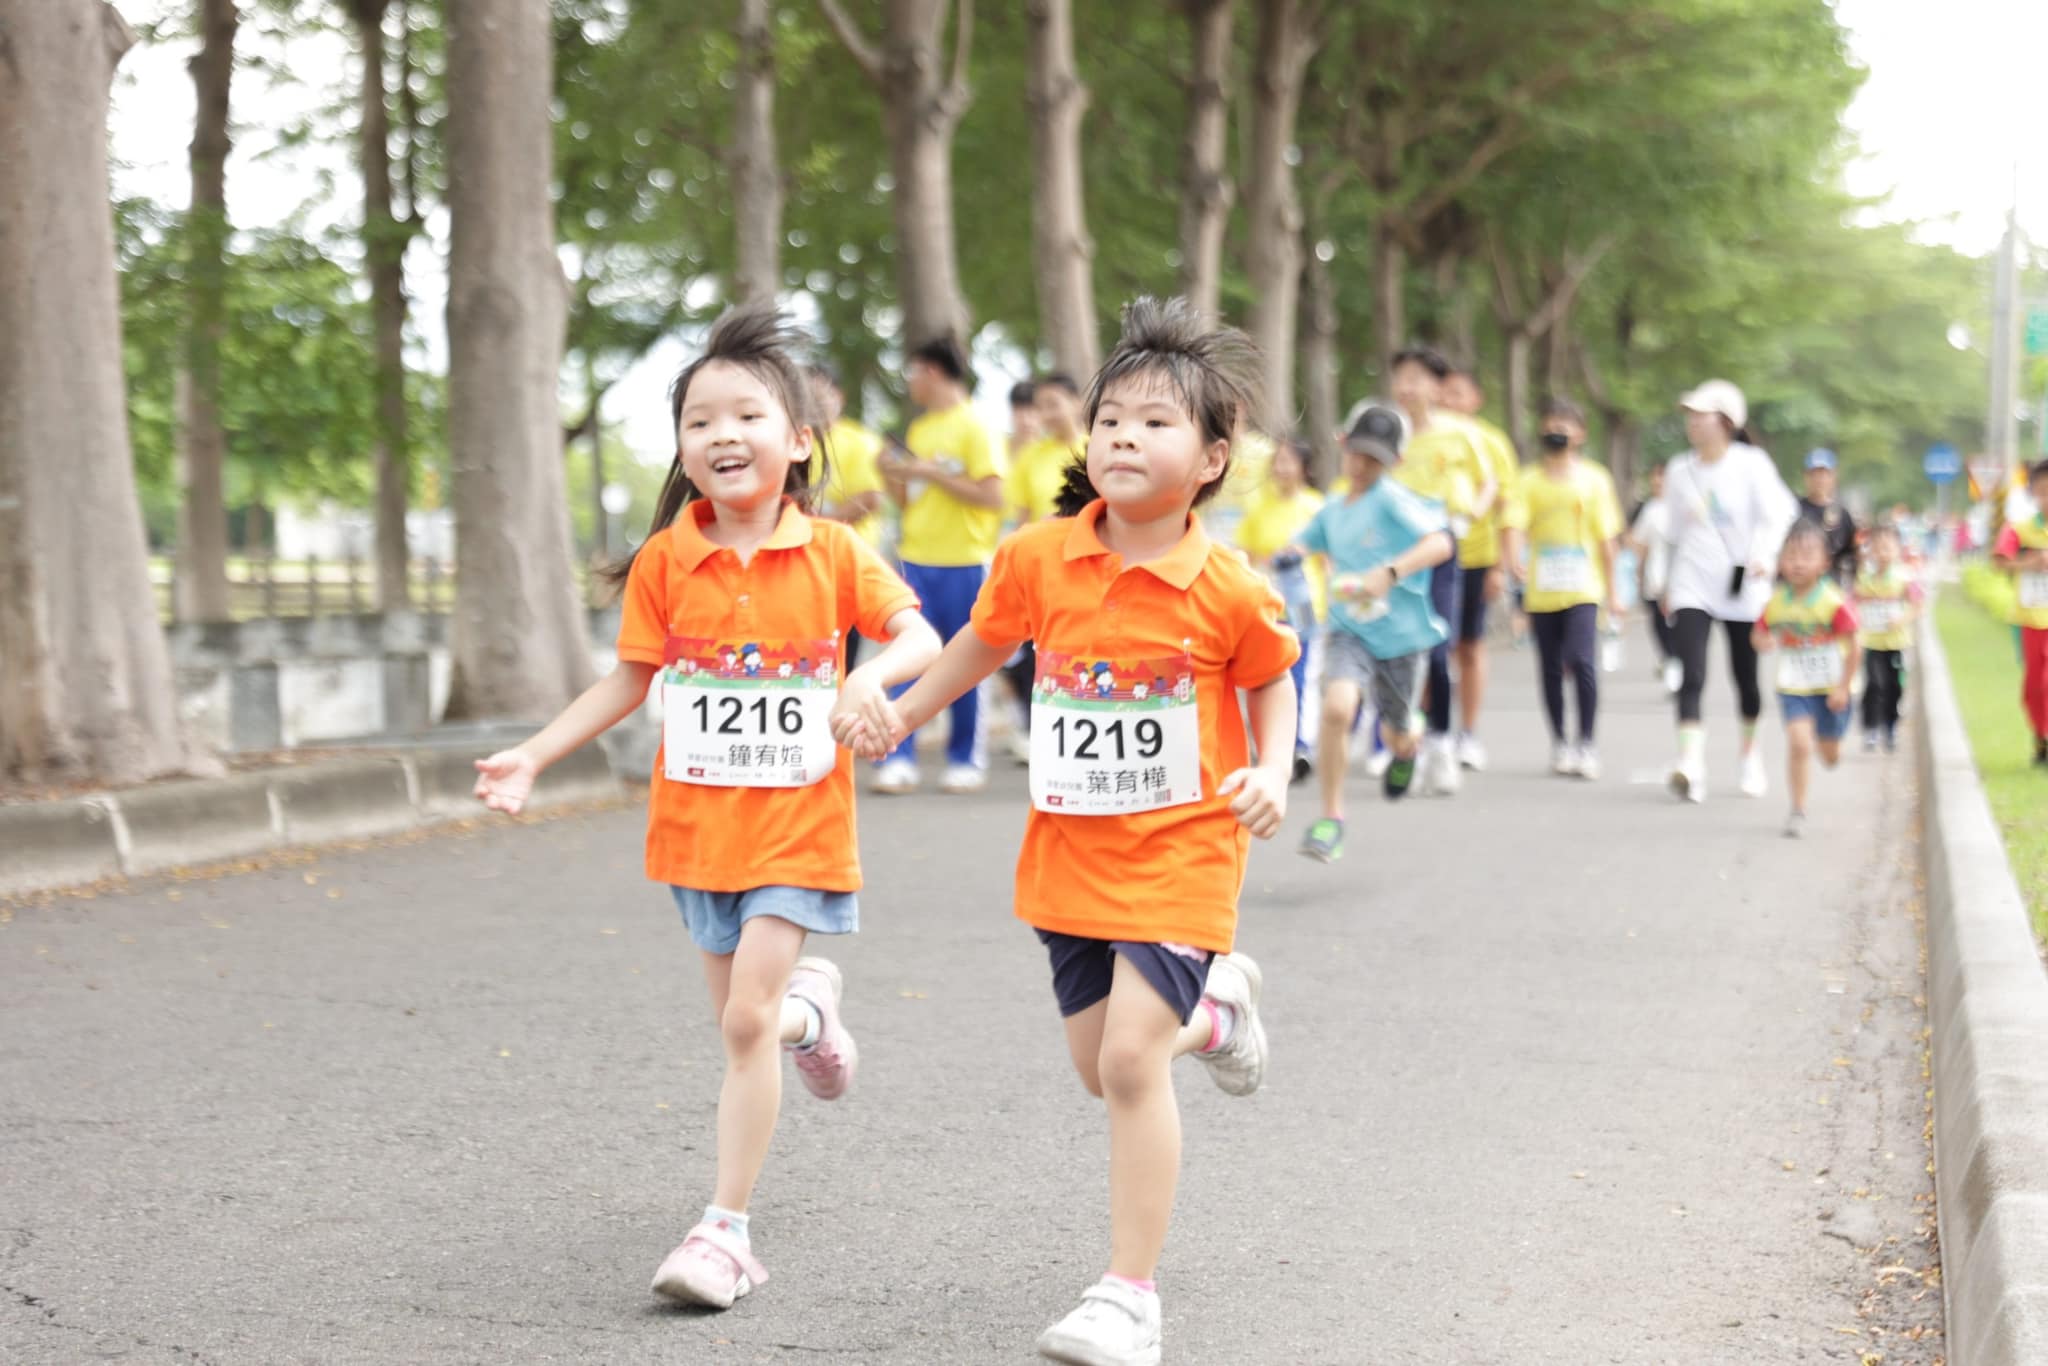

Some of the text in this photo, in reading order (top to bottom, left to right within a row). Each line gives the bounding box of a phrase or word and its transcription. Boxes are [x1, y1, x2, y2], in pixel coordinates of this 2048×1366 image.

[692, 694, 804, 735] 1216
[1052, 716, 1164, 760] 1219
[1086, 766, 1167, 795] 葉育樺
